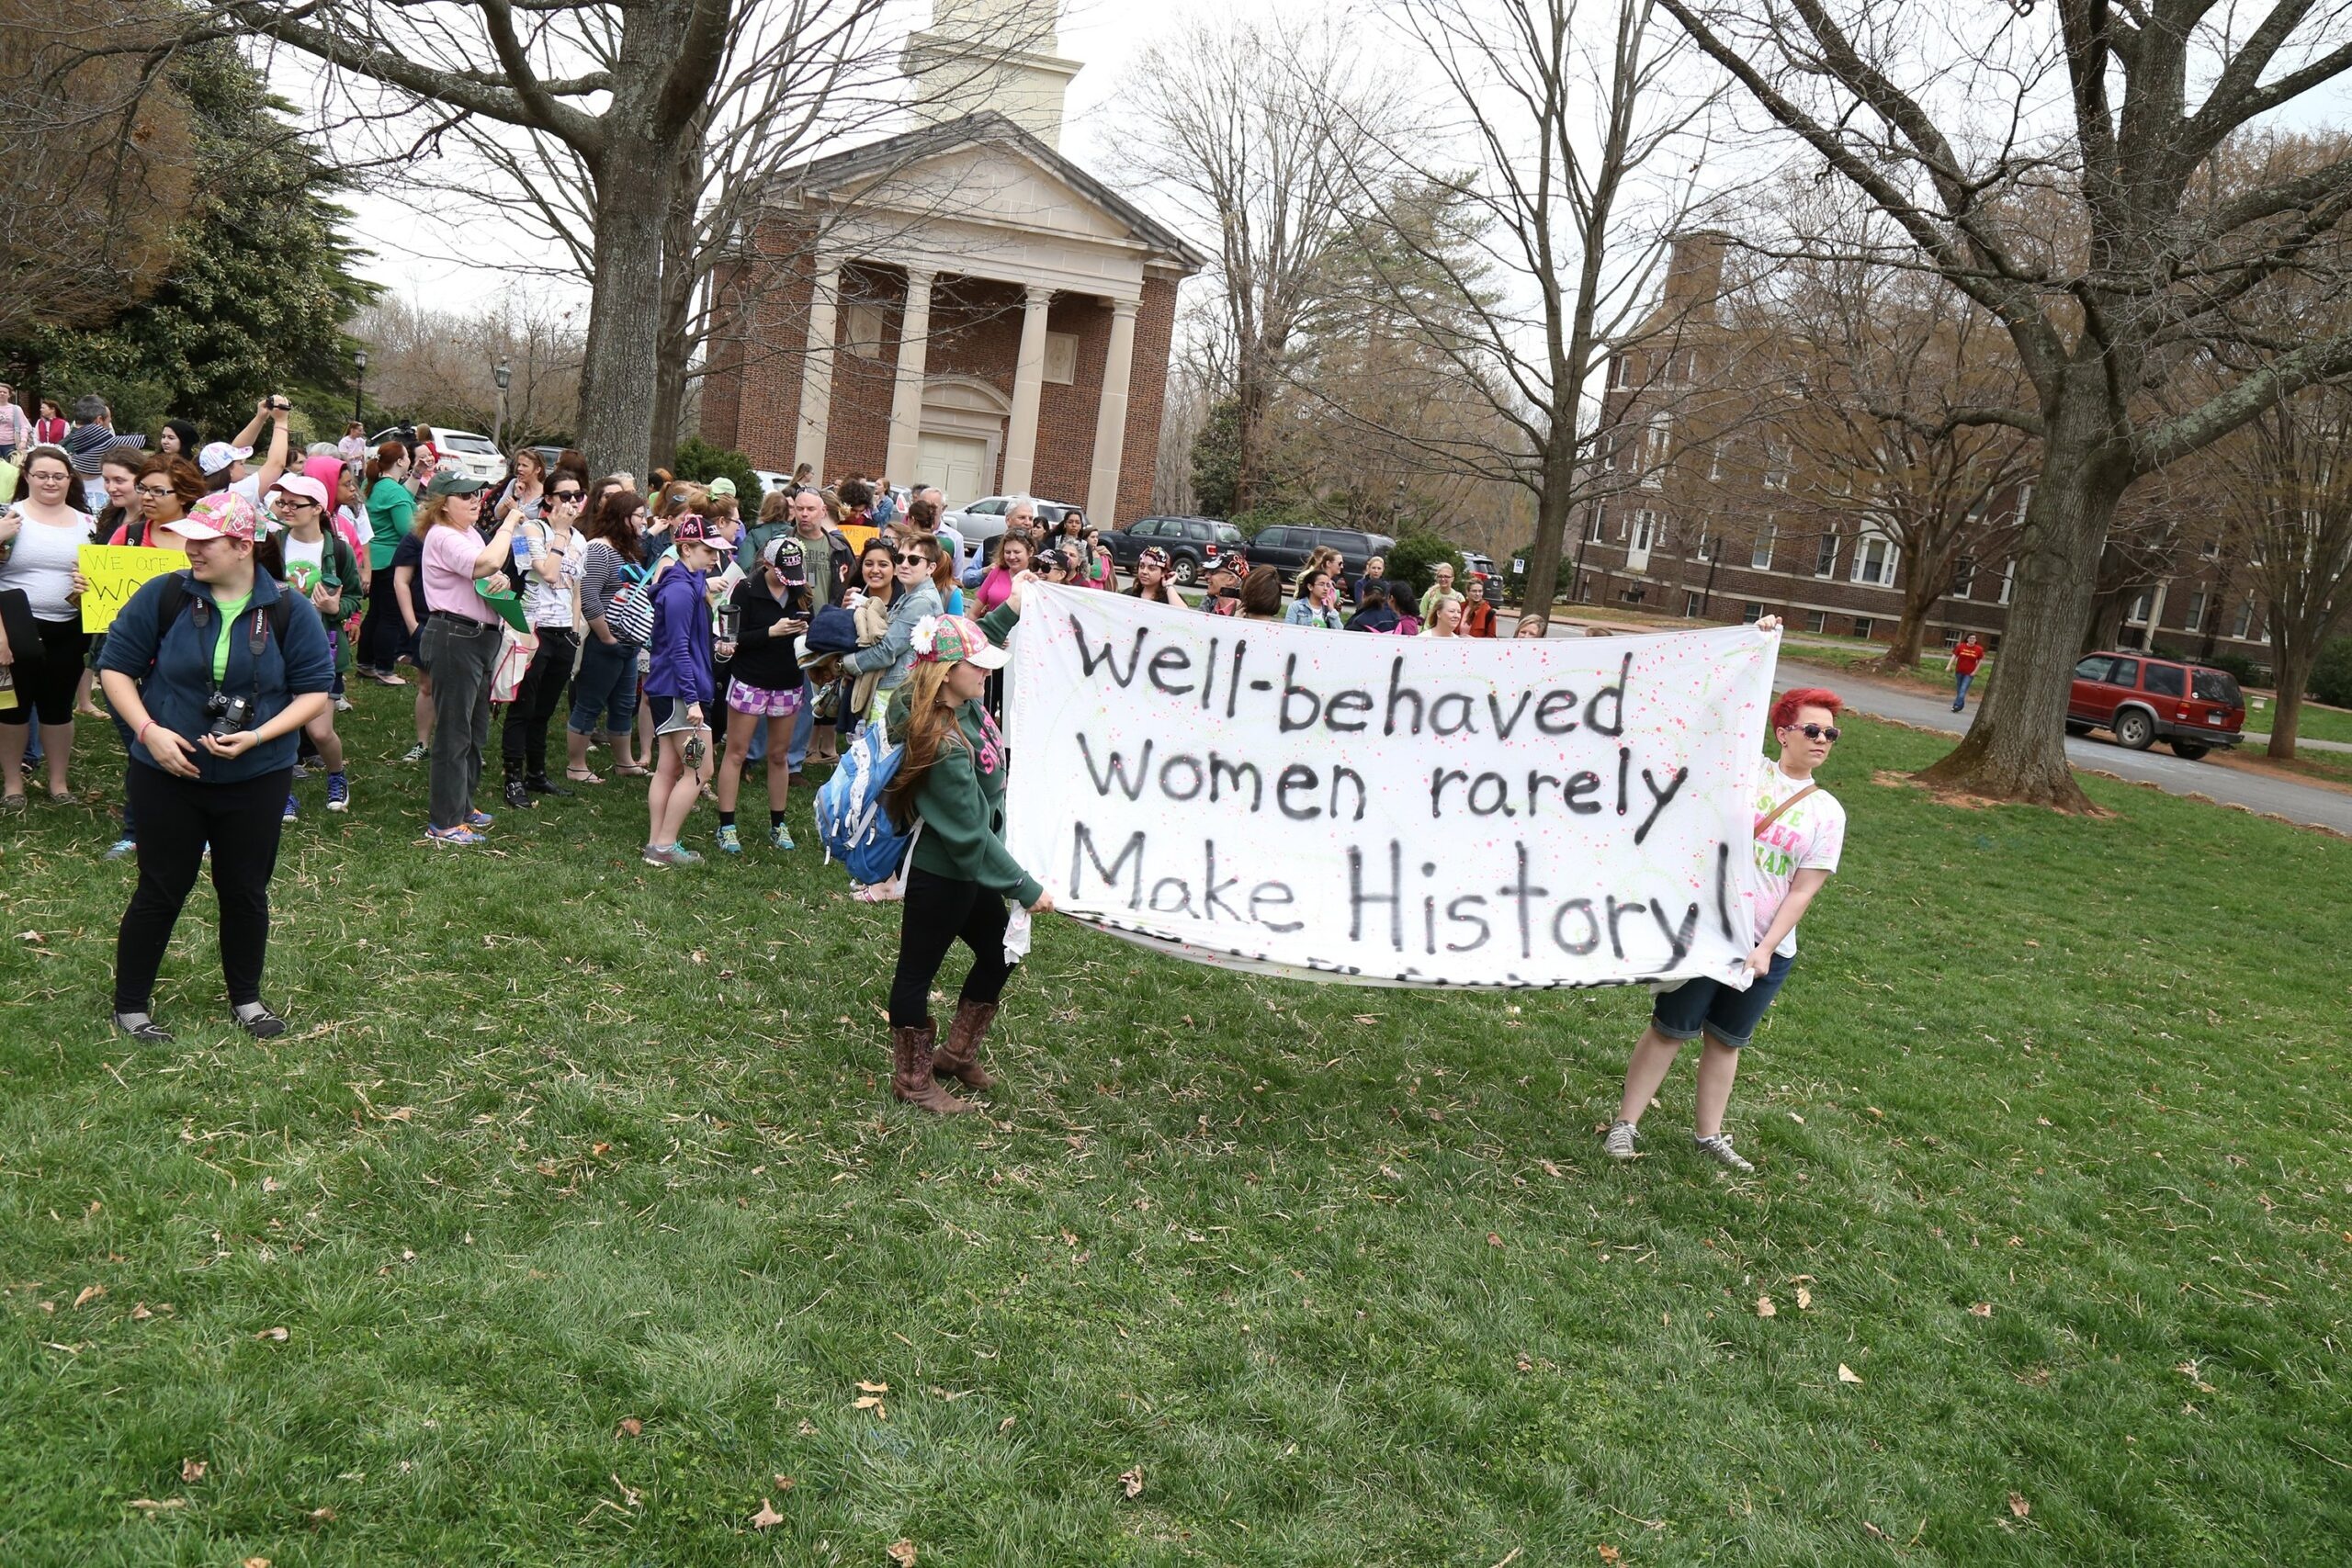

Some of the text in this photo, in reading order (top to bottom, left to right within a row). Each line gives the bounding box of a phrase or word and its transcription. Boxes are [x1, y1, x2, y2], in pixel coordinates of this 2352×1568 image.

[1069, 614, 1633, 740] Well-behaved
[1076, 732, 1368, 822] Women
[1429, 746, 1689, 845] rarely
[1069, 821, 1305, 934] Make
